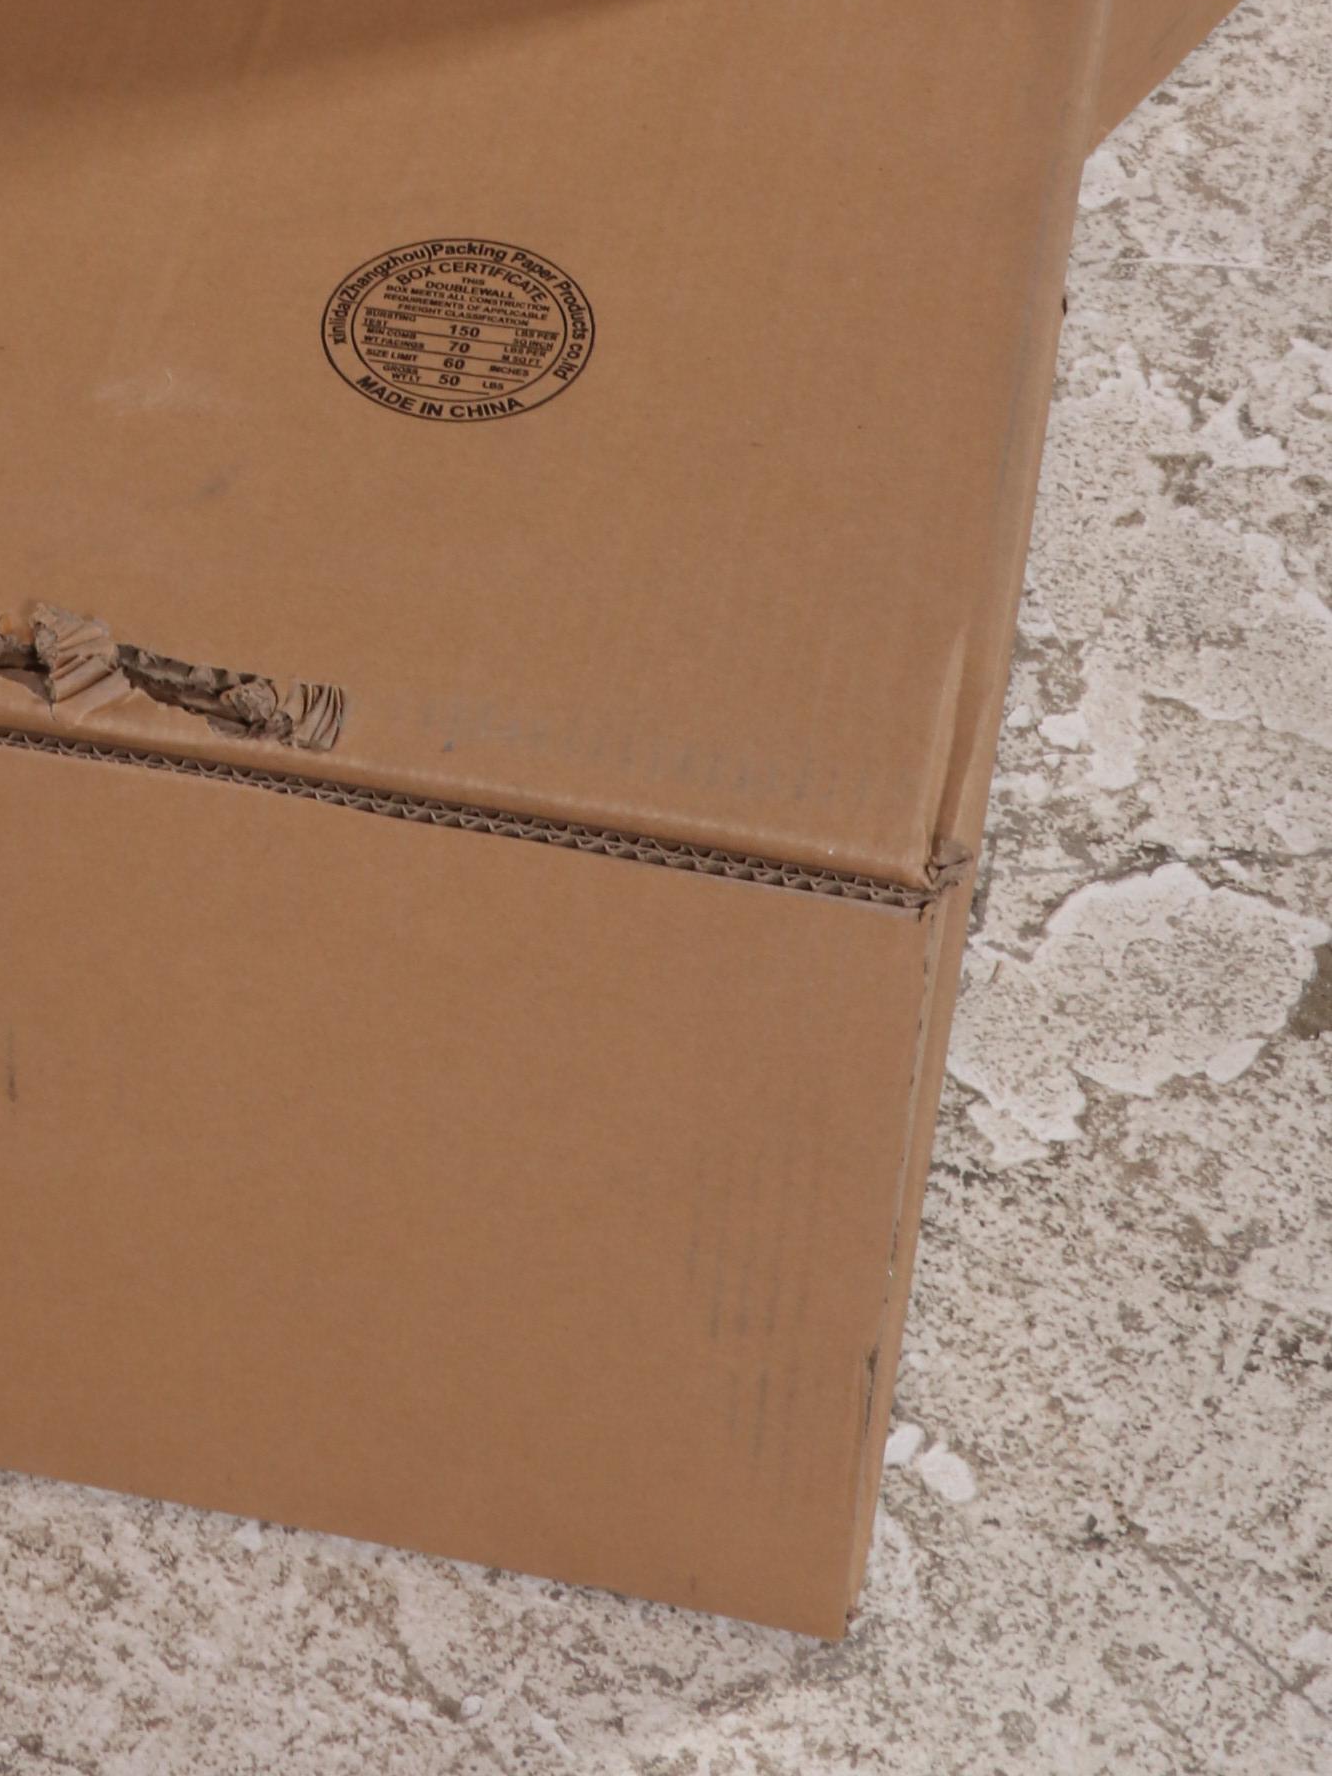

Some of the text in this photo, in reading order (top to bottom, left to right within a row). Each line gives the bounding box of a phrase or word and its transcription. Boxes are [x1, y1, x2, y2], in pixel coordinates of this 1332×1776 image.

[396, 261, 547, 302] BOX CERTIFICATE
[461, 276, 486, 286] THIS
[383, 293, 547, 321] REQUIREMENTS OF APPLICABLE
[386, 285, 550, 312] BOX MEETS ALL CONSTRUCTION
[511, 251, 558, 282] Paper
[554, 280, 589, 340] Products
[397, 303, 530, 326] FREIGHT CLASSIFICATION
[449, 324, 480, 337] 150
[448, 341, 470, 354] 70
[365, 348, 529, 377] SIZE LIMIT 60 INCHES
[438, 374, 504, 391] 50 LBS
[356, 375, 525, 418] MADE IN CHINA
